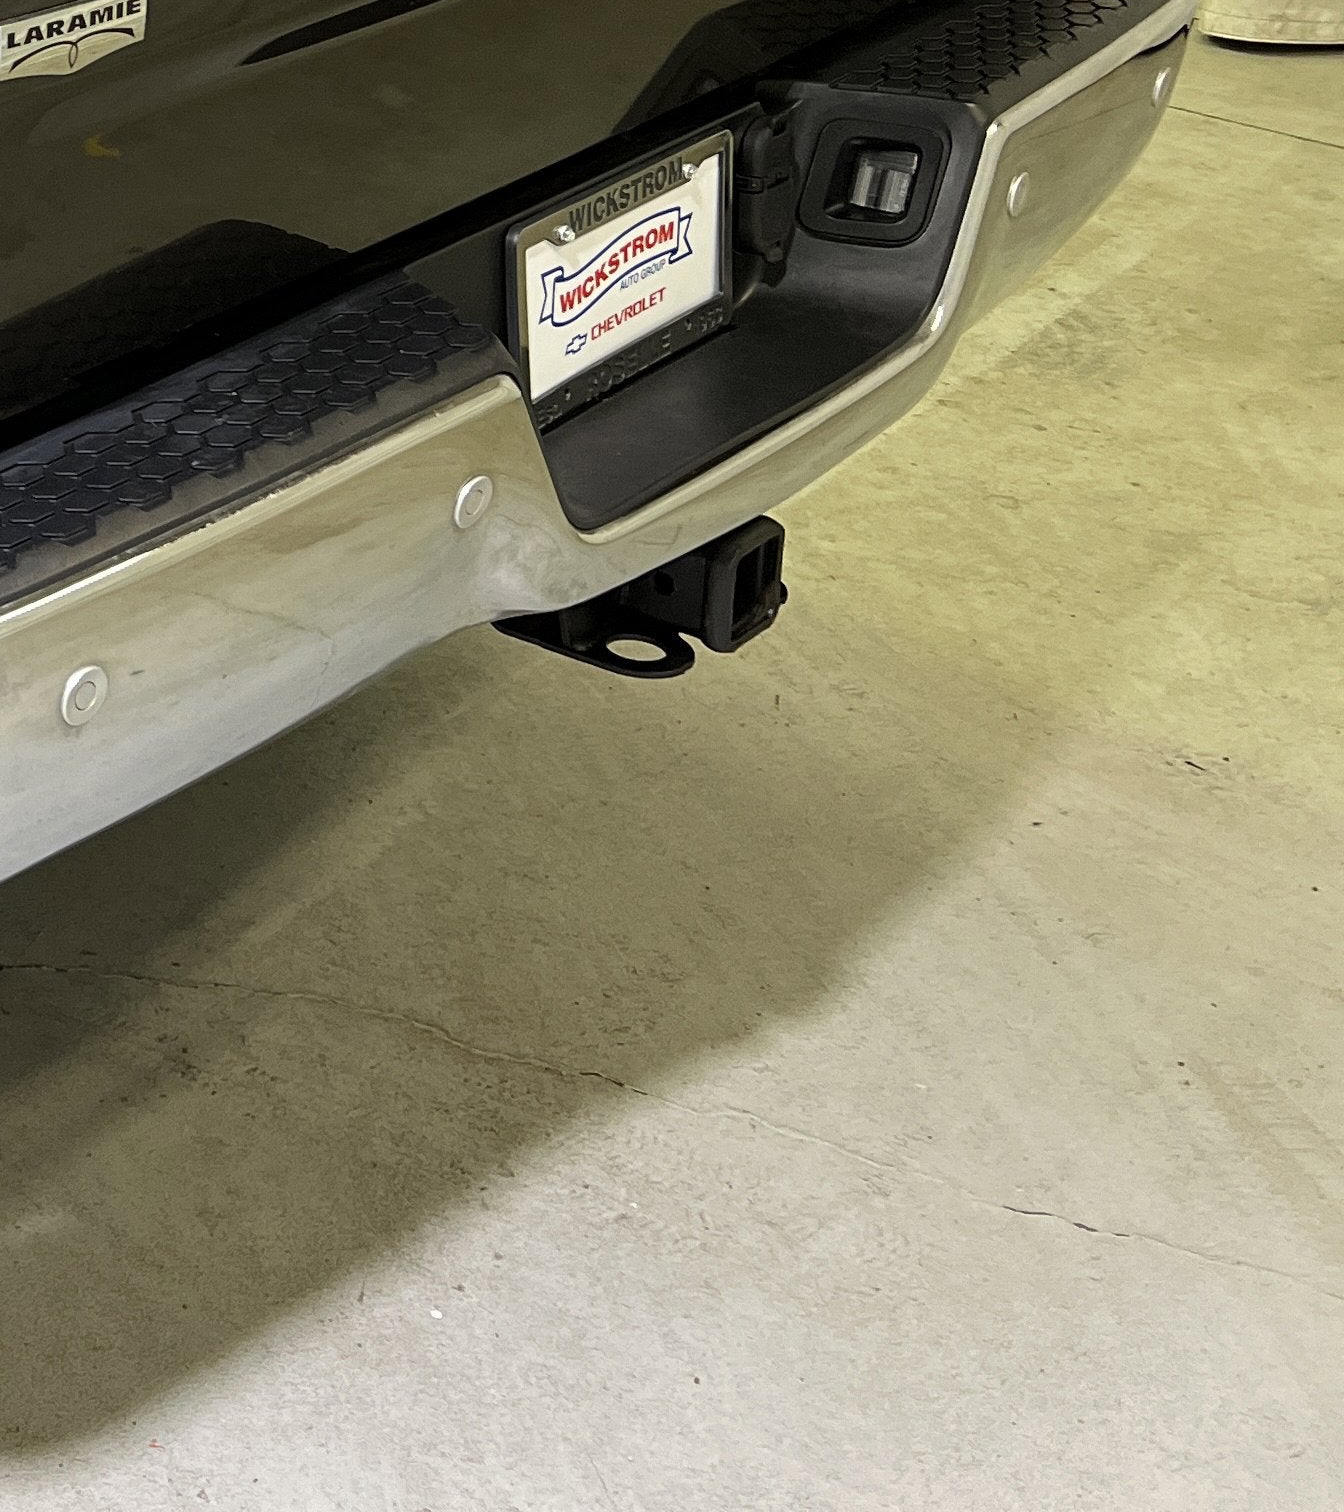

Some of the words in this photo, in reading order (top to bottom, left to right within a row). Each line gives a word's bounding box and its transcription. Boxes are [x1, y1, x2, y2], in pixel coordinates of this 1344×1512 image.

[569, 156, 685, 232] WICKSTROM
[559, 221, 674, 313] WICKSTROM
[620, 273, 639, 290] AUTO
[641, 259, 666, 280] GROUP
[591, 287, 667, 341] CHEVROLET
